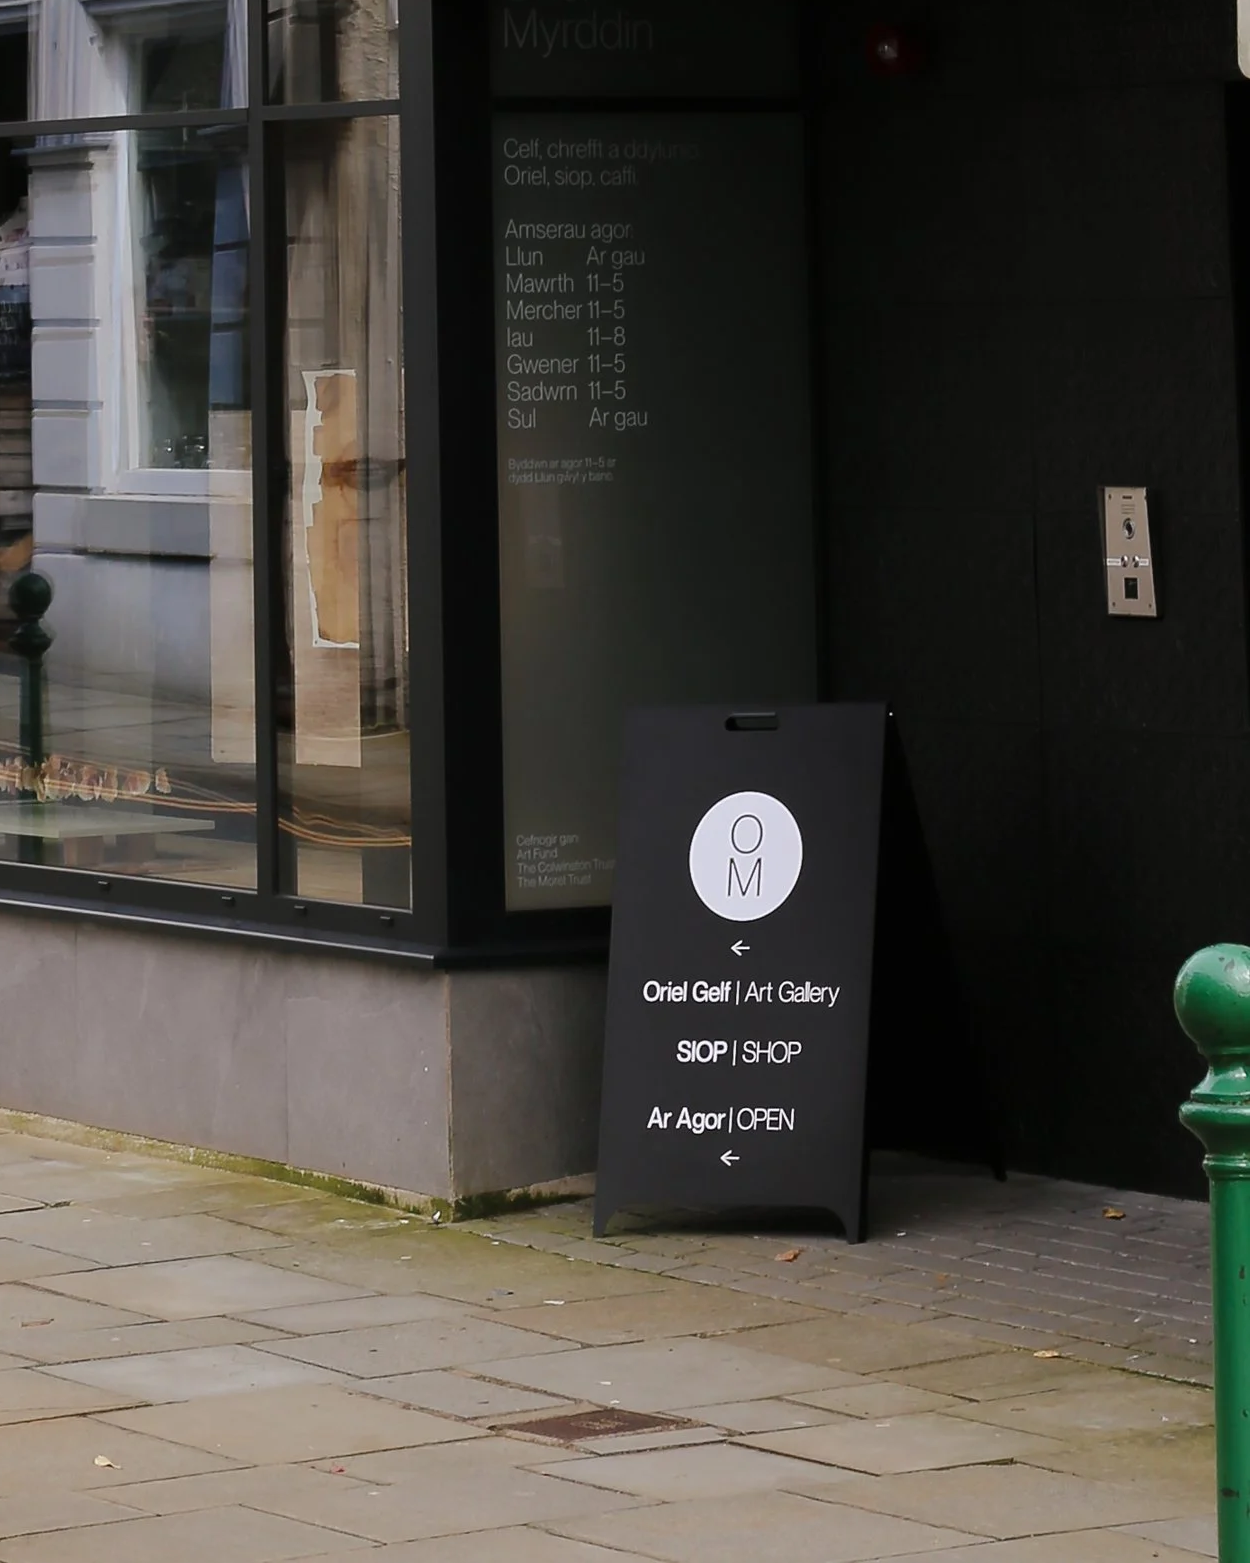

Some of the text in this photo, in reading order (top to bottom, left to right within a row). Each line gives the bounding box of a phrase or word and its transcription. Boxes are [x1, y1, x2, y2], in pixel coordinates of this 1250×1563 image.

[502, 7, 654, 59] Myrddin
[503, 138, 543, 162] Celf,
[503, 164, 551, 188] Oriel,
[505, 218, 586, 239] Amserau
[505, 245, 645, 270] Llun Ar gau
[506, 272, 575, 293] Mawrth
[506, 299, 582, 320] Mercher
[507, 327, 534, 348] Iau
[507, 353, 579, 374] Gwener
[507, 380, 578, 402] Sadwrn
[507, 407, 648, 431] Sul Ar gau
[516, 847, 559, 860] Art Fund
[517, 862, 537, 874] The
[517, 876, 537, 888] The
[643, 979, 688, 1003] Oriel
[692, 979, 732, 1003] Gelf
[744, 980, 773, 1003] Art
[777, 981, 840, 1008] Gallery
[676, 1039, 729, 1063] SIOP
[741, 1040, 802, 1064] SHOP
[647, 1105, 673, 1130] Ar
[675, 1105, 726, 1135] Agor
[736, 1107, 795, 1131] OPEN
